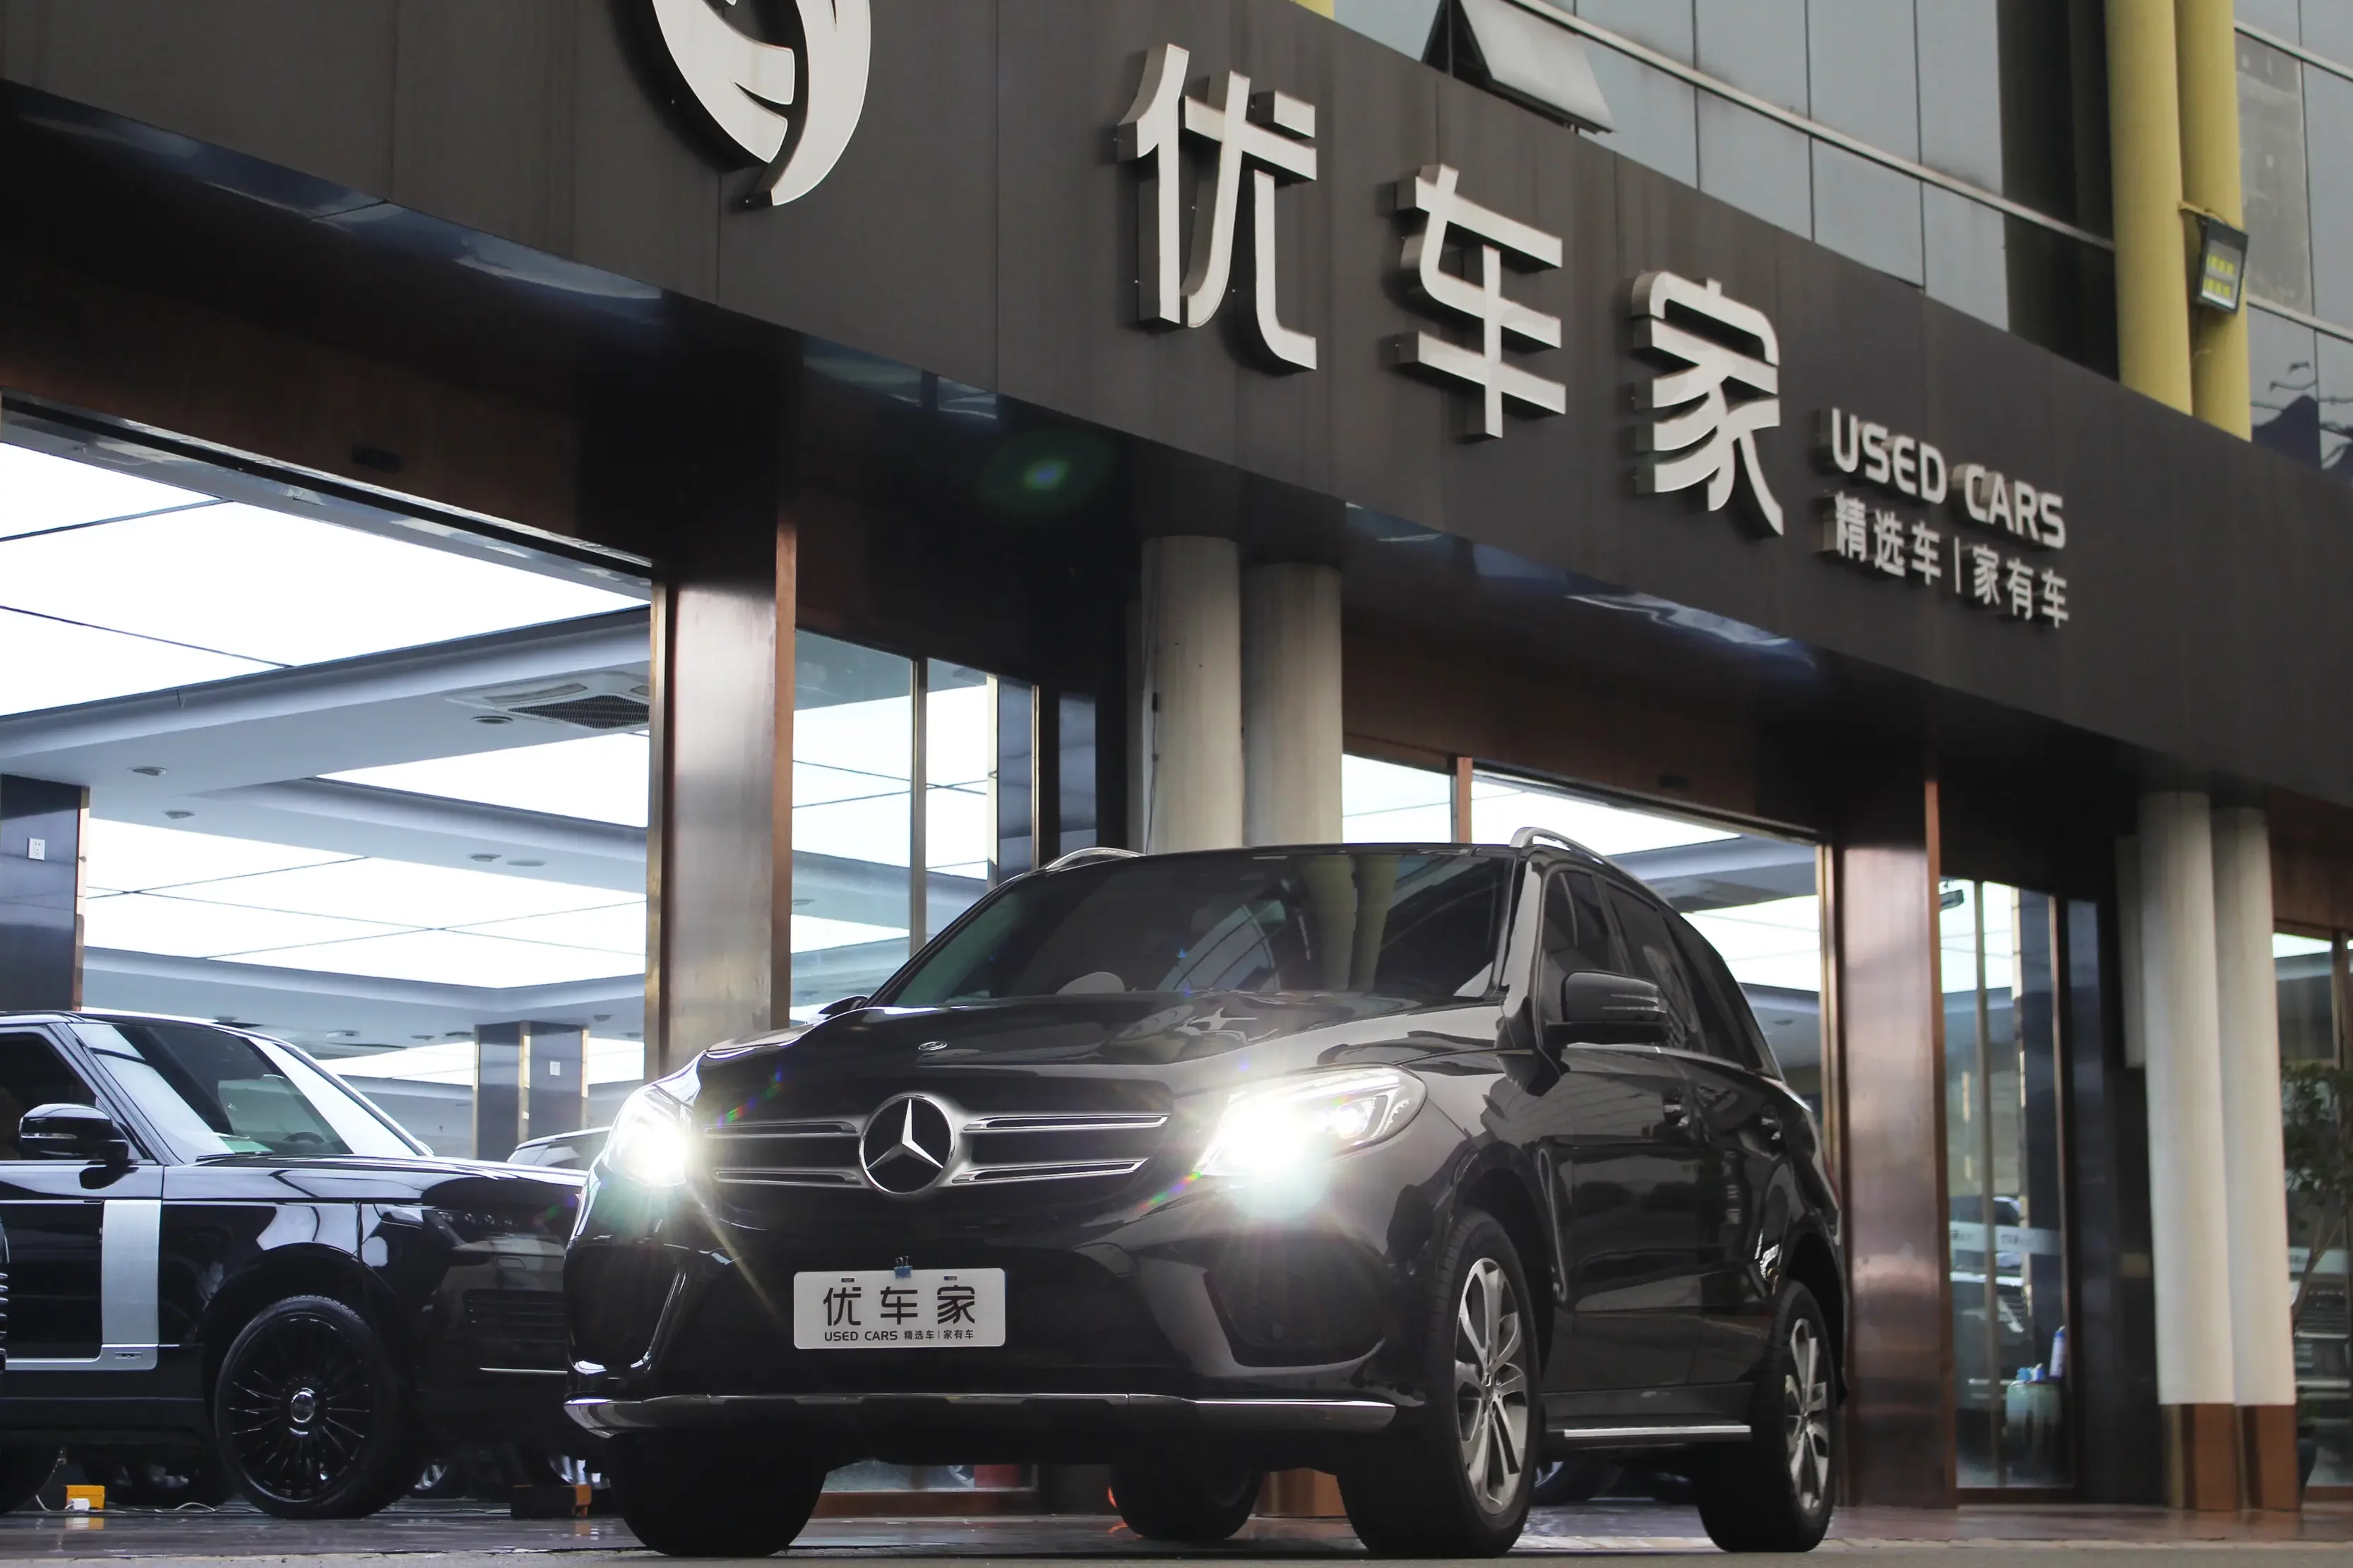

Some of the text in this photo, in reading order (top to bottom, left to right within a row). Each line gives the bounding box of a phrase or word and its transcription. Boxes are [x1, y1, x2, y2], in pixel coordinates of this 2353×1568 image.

[1132, 42, 1784, 536] 优车家
[1831, 407, 2066, 550] USED CARS
[823, 1284, 976, 1327] 优车家
[824, 1331, 859, 1342] USED
[864, 1330, 898, 1341] CARS
